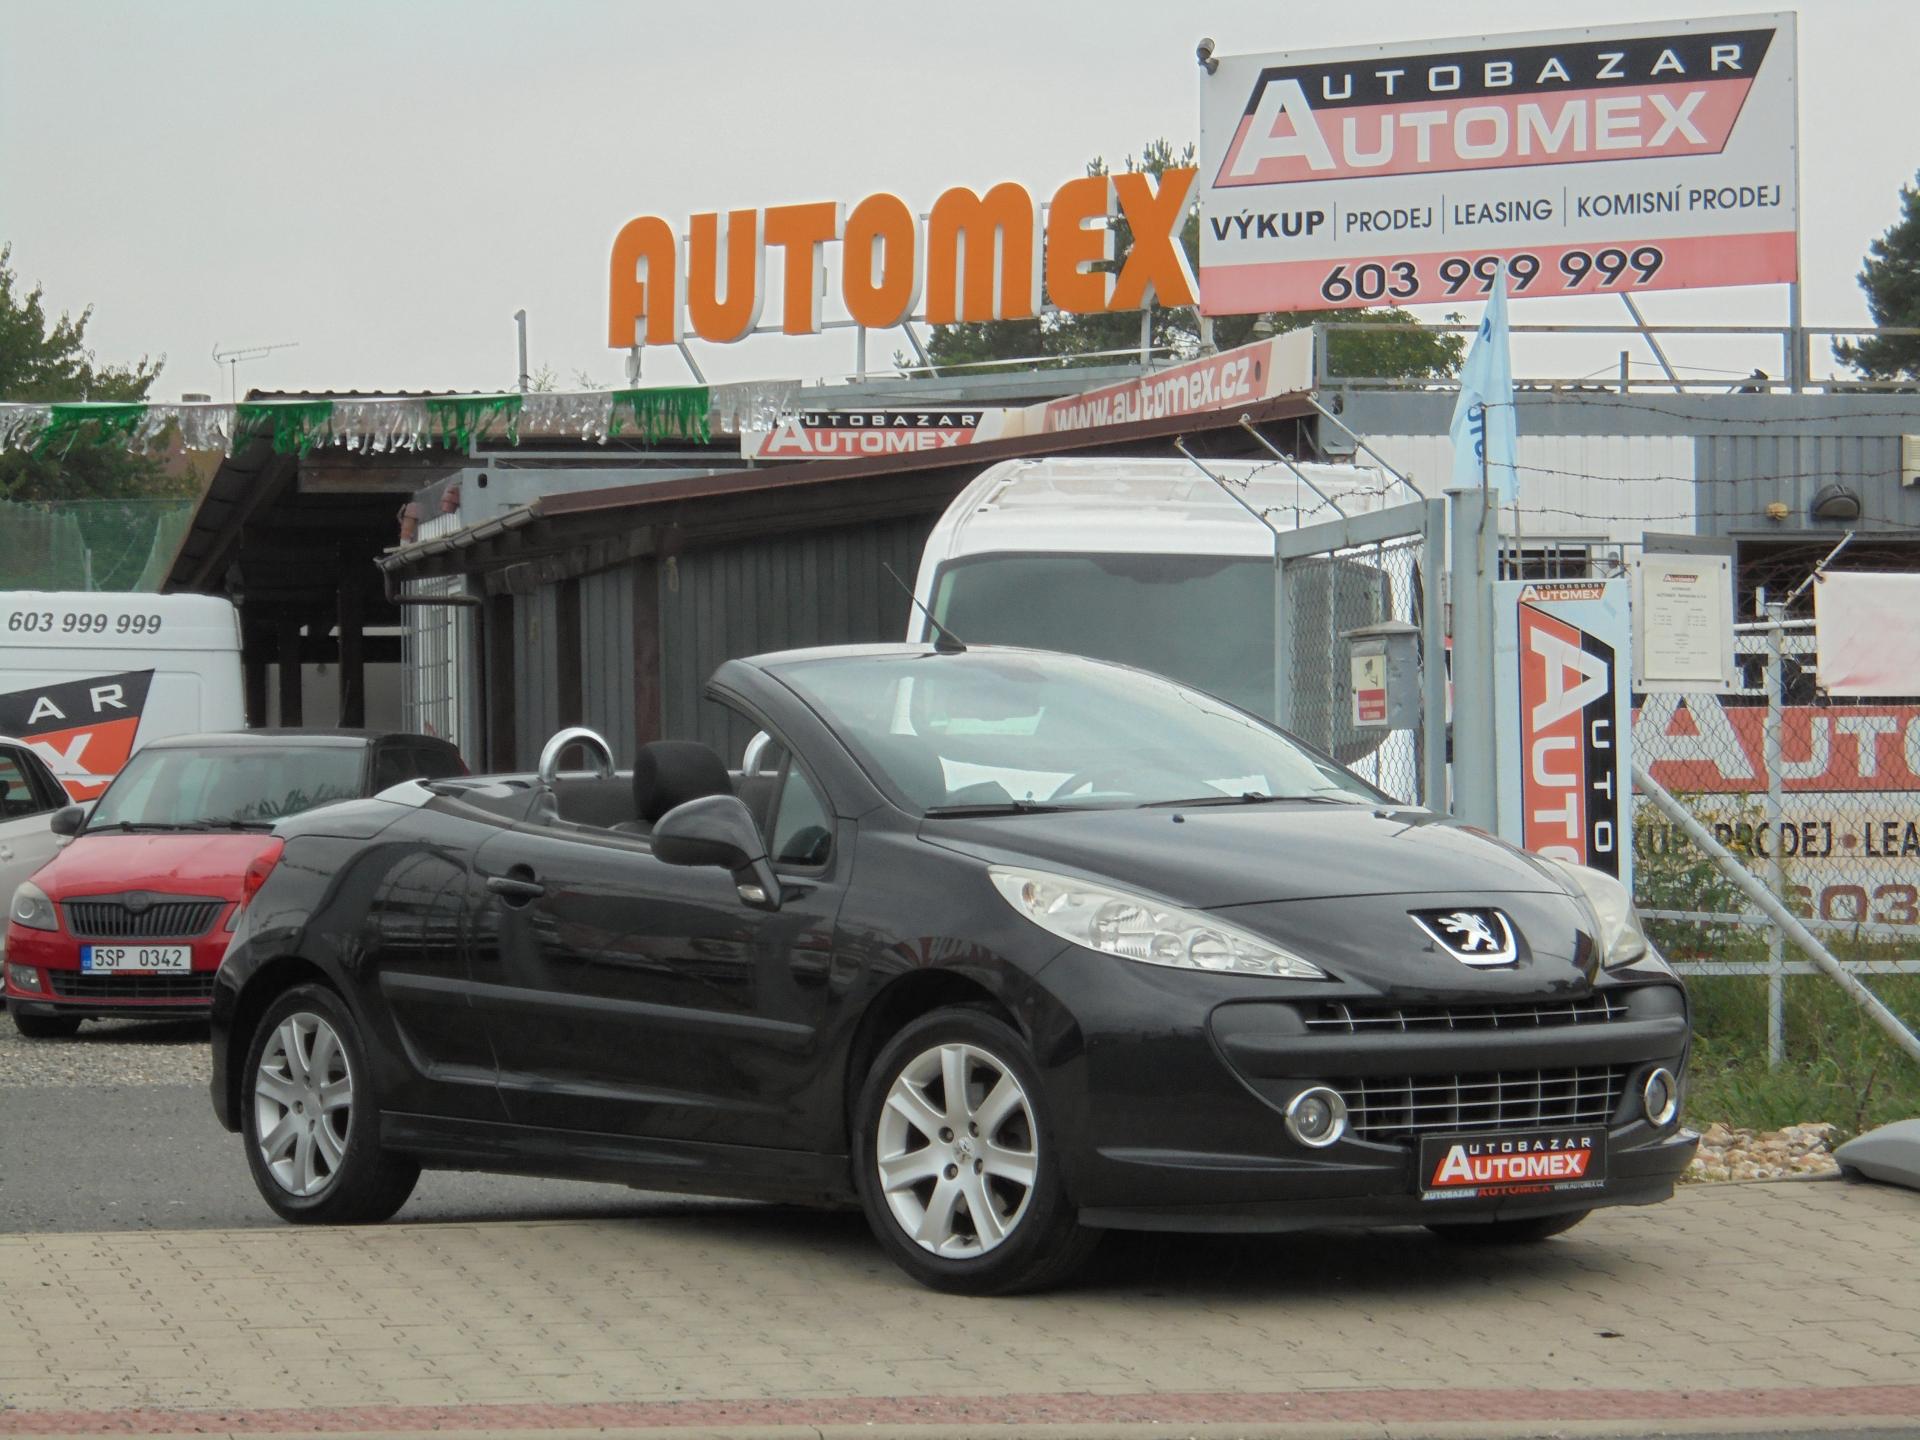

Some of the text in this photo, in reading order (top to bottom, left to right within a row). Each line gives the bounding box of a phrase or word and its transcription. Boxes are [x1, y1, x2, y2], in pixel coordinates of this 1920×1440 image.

[1228, 78, 1709, 177] AUTOMEX
[1210, 184, 1782, 242] VÝKUP PRODEJ LEASING KOMISNÍ PRODEJ
[608, 166, 1200, 348] AUTOMEX
[1320, 246, 1664, 302] 603 999 999
[1054, 356, 1250, 433] www.automex.cz
[766, 419, 962, 454] AUTOMEX
[1521, 584, 1601, 601] AUTOMEX
[8, 611, 162, 635] 603 999 999
[95, 949, 182, 967] 5SP 0342
[1438, 1144, 1583, 1182] AUTOMEX
